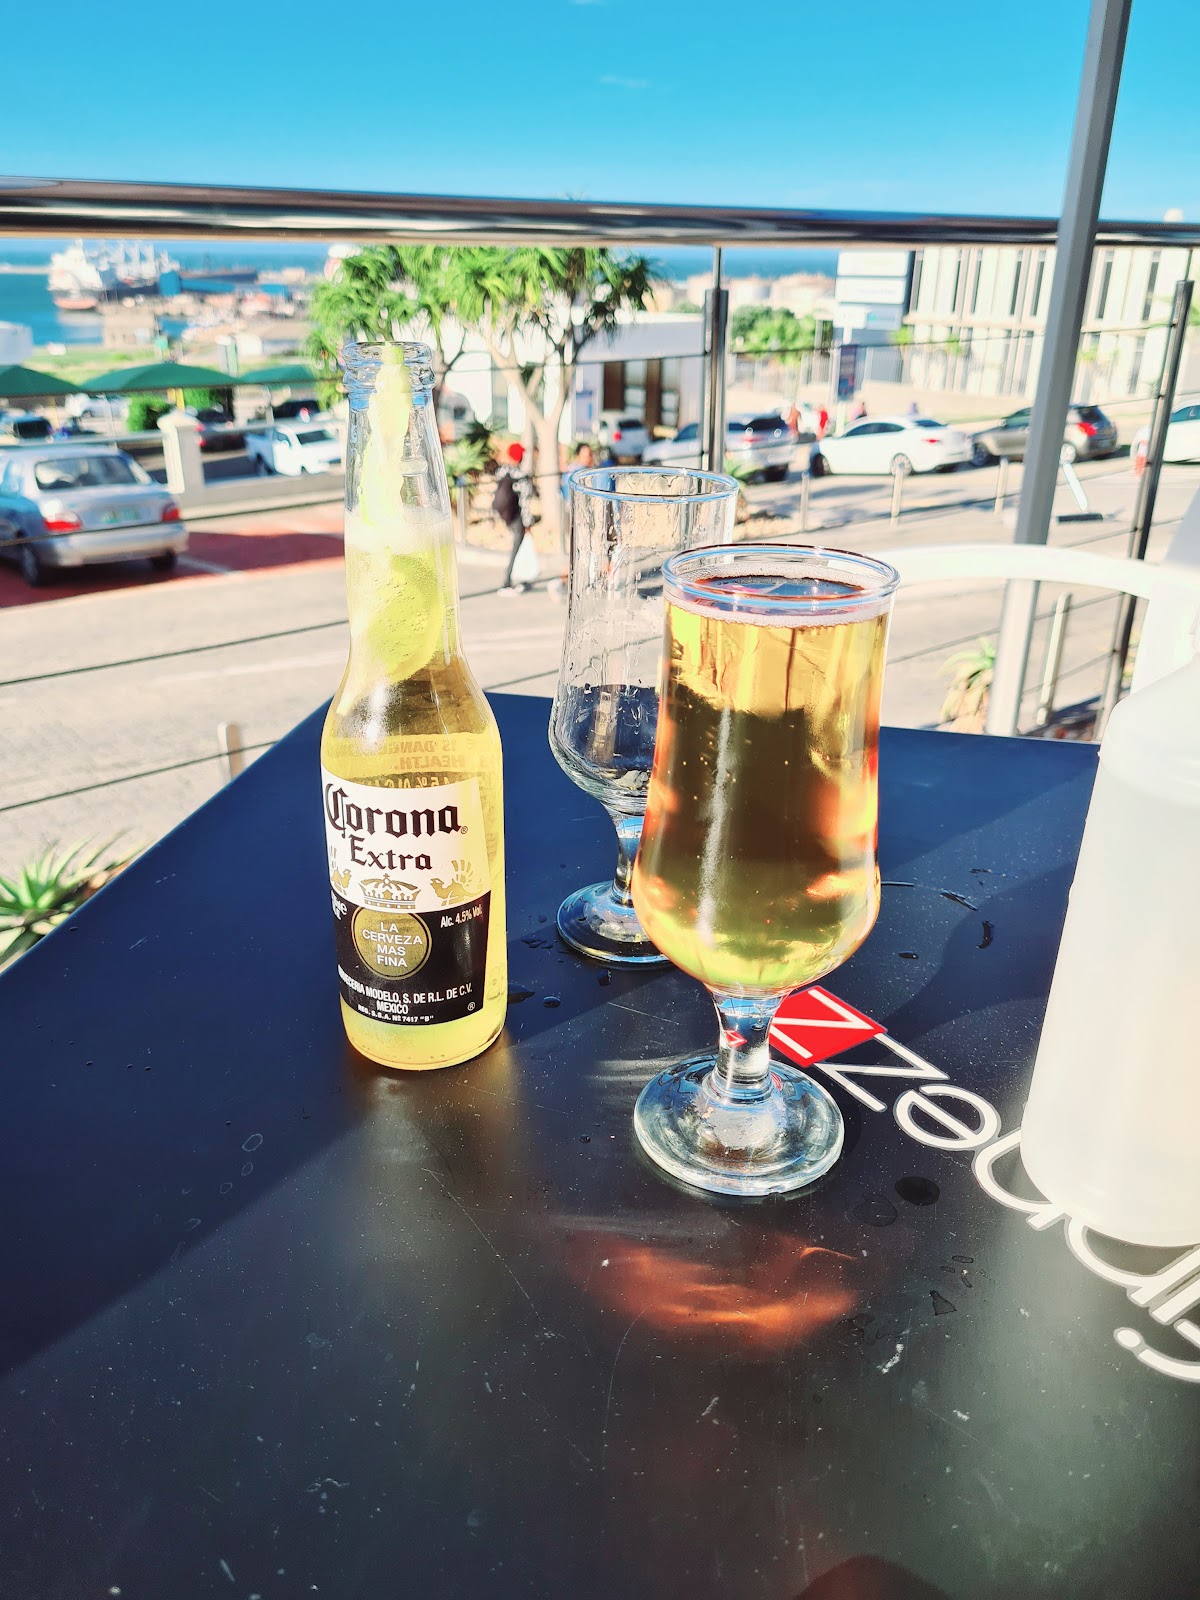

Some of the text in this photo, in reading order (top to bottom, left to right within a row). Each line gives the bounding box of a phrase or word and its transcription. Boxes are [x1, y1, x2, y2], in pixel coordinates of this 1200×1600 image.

[325, 783, 461, 839] Corona
[349, 834, 433, 871] Extra
[441, 915, 455, 928] Alc.
[455, 909, 473, 924] 4.5%
[380, 922, 399, 933] LA
[362, 929, 423, 945] CERVEZA
[377, 944, 406, 956] MAS
[377, 956, 408, 968] FINA
[365, 985, 401, 1004] MODELO,
[403, 993, 412, 1004] S.
[413, 993, 426, 1004] DE
[428, 991, 445, 1003] R.L.
[446, 987, 459, 999] DE
[459, 983, 473, 996] C.V.
[376, 1000, 409, 1015] MEXICO
[401, 1015, 419, 1023] 7417
